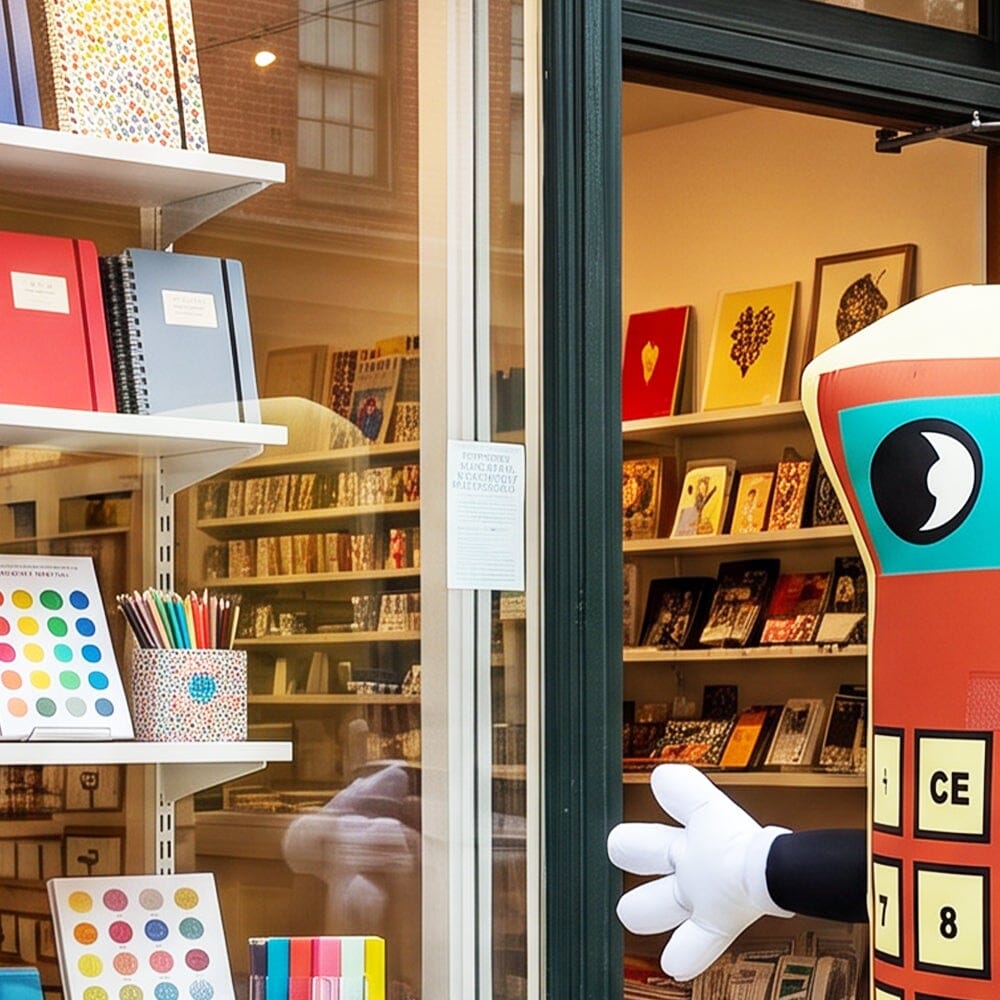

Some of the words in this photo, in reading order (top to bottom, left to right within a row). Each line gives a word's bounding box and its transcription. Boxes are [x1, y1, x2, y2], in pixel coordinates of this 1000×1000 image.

[929, 771, 970, 806] CE
[878, 894, 889, 927] 7
[939, 906, 958, 940] 8
